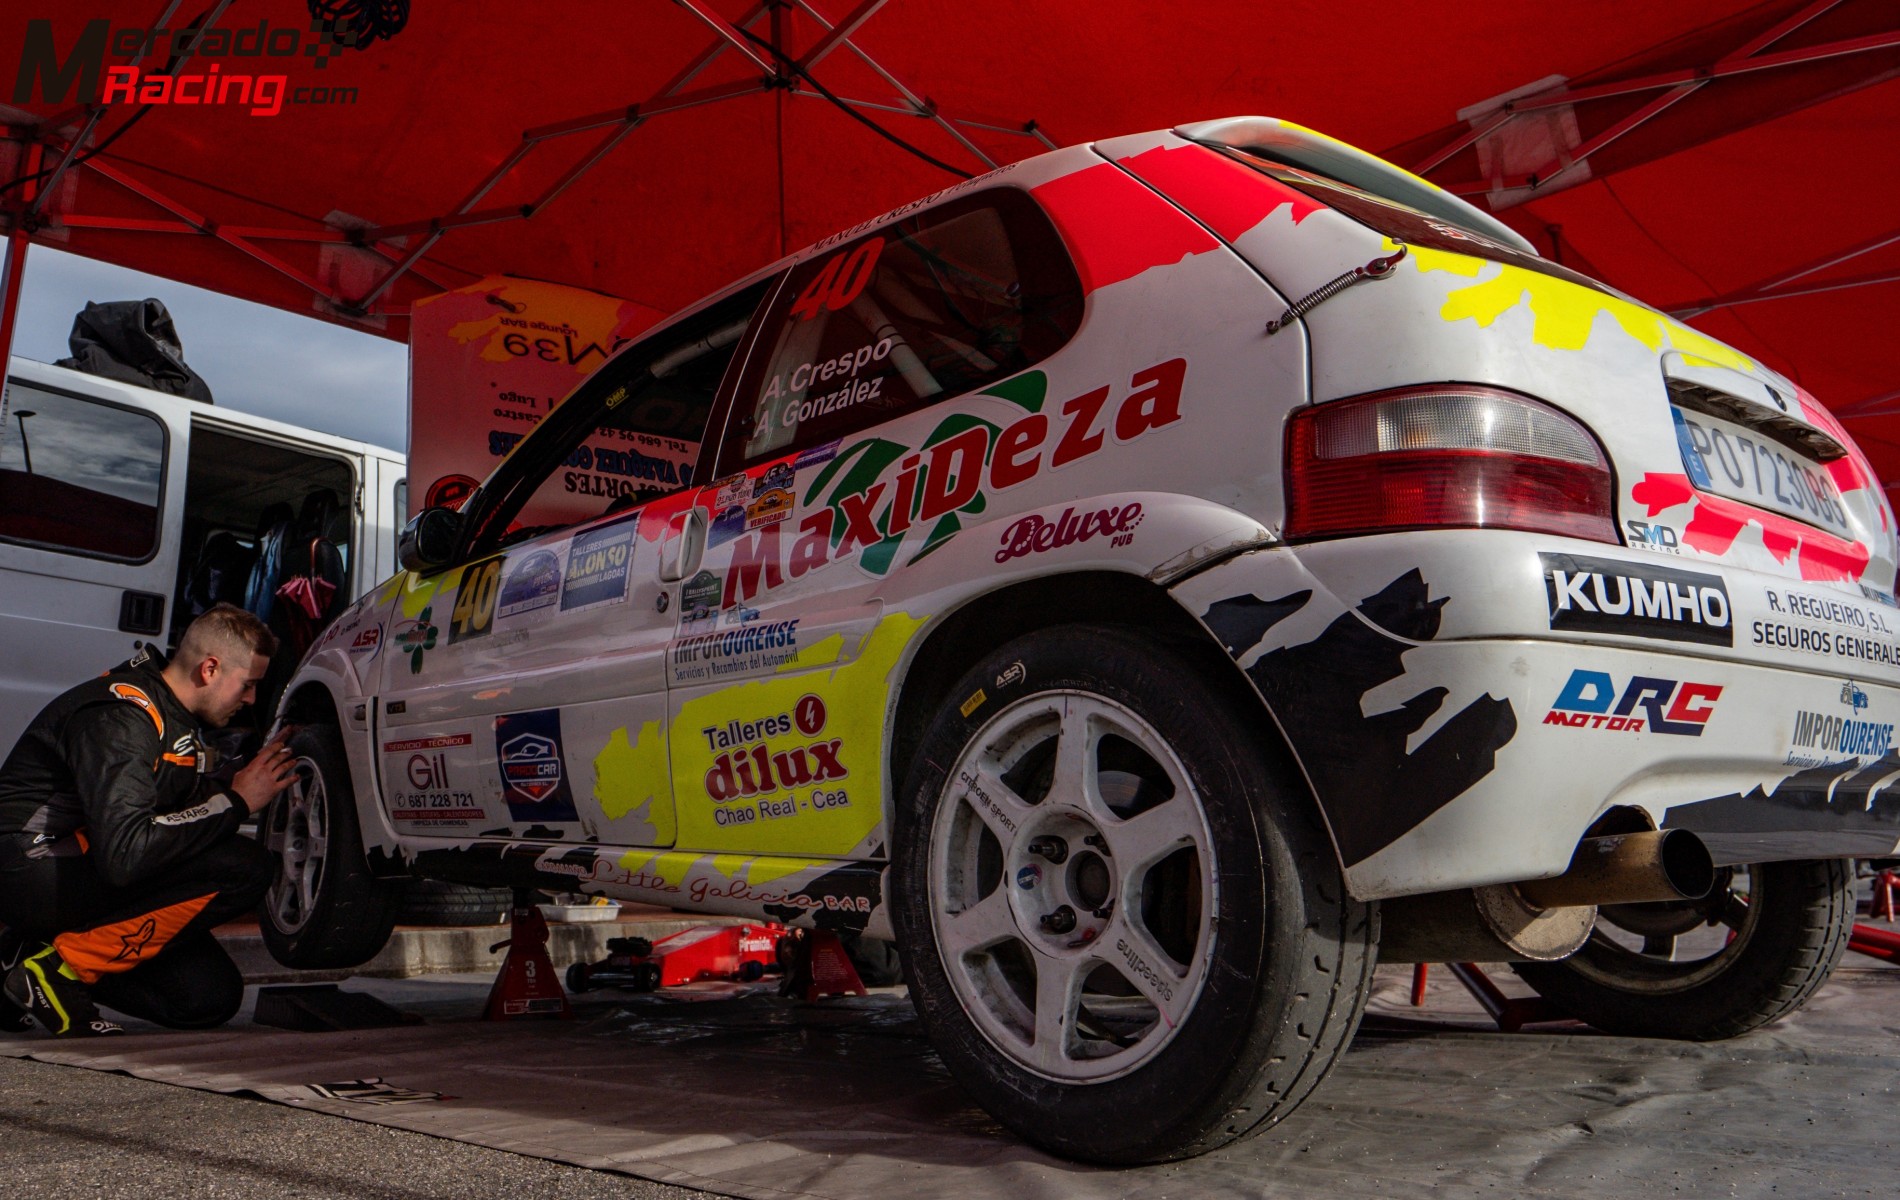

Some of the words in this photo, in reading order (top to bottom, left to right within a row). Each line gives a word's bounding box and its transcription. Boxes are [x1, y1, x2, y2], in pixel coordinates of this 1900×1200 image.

[809, 218, 874, 254] MANUEL
[876, 190, 944, 225] CRESPO
[788, 236, 886, 322] 40
[500, 316, 529, 329] BAR
[531, 321, 578, 338] Lounge
[498, 391, 536, 408] Lugo
[782, 376, 884, 428] González
[618, 429, 636, 443] 95
[638, 434, 662, 448] 686
[594, 446, 680, 485] VAZQUEZ
[721, 357, 1188, 611] MaxiDeza
[750, 511, 787, 528] VERIFICADO
[994, 502, 1144, 564] Deluxe
[1627, 519, 1678, 548] SMD
[572, 540, 603, 557] TALLERES
[1110, 533, 1134, 549] PUB
[567, 544, 627, 581] ALONSO
[598, 567, 626, 584] LAGOAS
[451, 559, 501, 634] 40
[1552, 569, 1730, 628] KUMHO
[1766, 590, 1786, 614] R.
[1869, 612, 1894, 635] S.L.
[351, 628, 379, 647] ASR
[674, 618, 801, 665] IMPOROURENSE
[1752, 621, 1832, 654] SEGUROS
[1835, 634, 1900, 666] GENERALE
[674, 667, 705, 681] Servicios
[711, 658, 748, 676] Recambios
[749, 656, 761, 669] del
[762, 647, 800, 668] Automóvil
[995, 663, 1024, 688] ASR
[1551, 668, 1724, 737] DRC
[703, 713, 792, 751] Talleres
[1542, 711, 1646, 733] MOTOR
[1791, 710, 1895, 757] IMPOROURENSE
[388, 741, 422, 752] SERVICIO
[407, 753, 449, 790] Gil
[507, 763, 557, 777] PRADOCAR
[704, 739, 849, 802] dilux
[166, 806, 209, 823] ASTARS
[408, 794, 427, 808] 687
[429, 793, 451, 808] 228
[452, 793, 475, 807] 721
[714, 806, 756, 826] Chao
[758, 795, 797, 819] Real
[811, 790, 849, 809] Cea
[990, 803, 1017, 834] SPORT
[578, 858, 682, 894] Little
[689, 877, 823, 909] Galicia
[824, 896, 872, 913] BAR
[524, 959, 537, 978] 3
[34, 985, 51, 1010] FIRST
